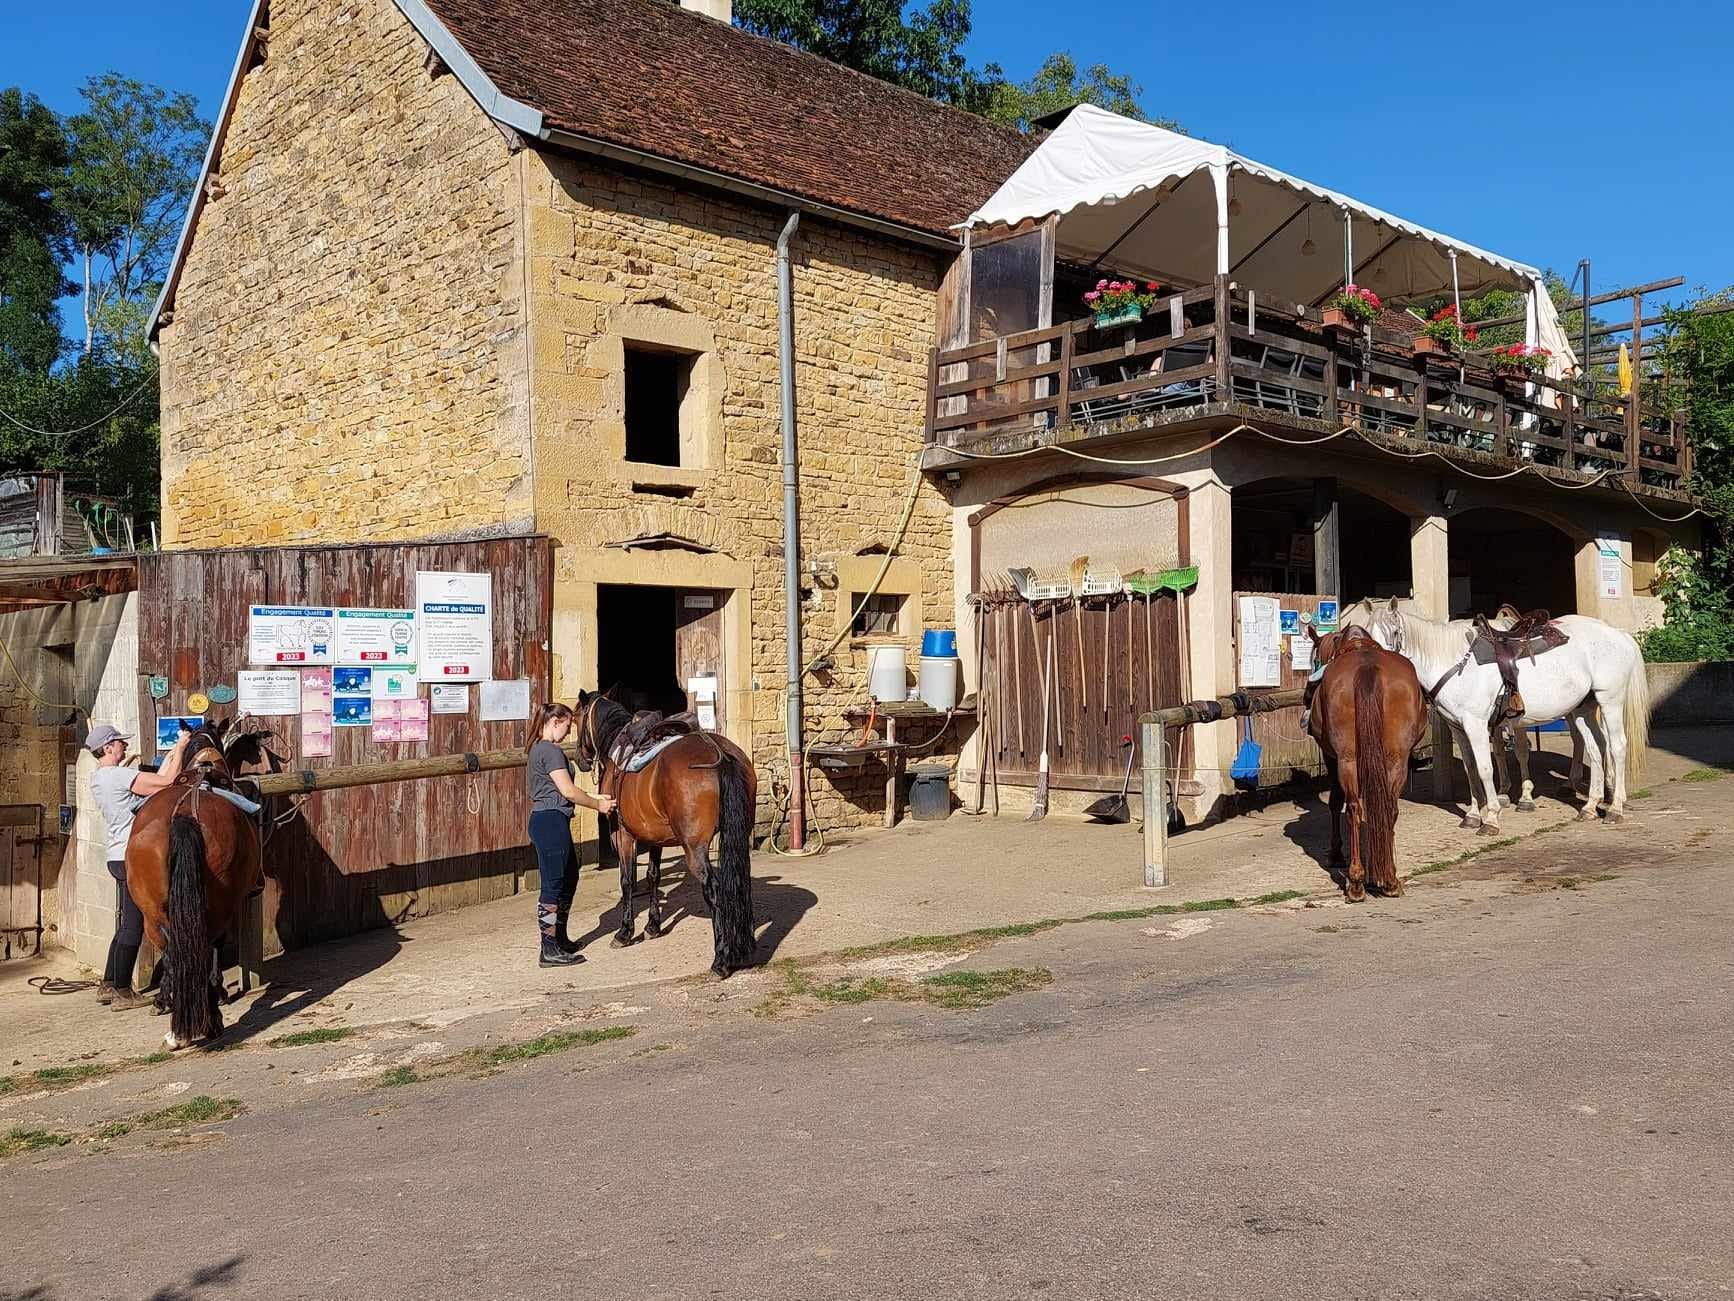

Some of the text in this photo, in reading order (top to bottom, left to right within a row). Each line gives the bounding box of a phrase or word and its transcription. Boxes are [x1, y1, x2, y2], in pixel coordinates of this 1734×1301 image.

[261, 608, 326, 617] Engagement Qualité
[459, 605, 484, 613] QUALITÉ
